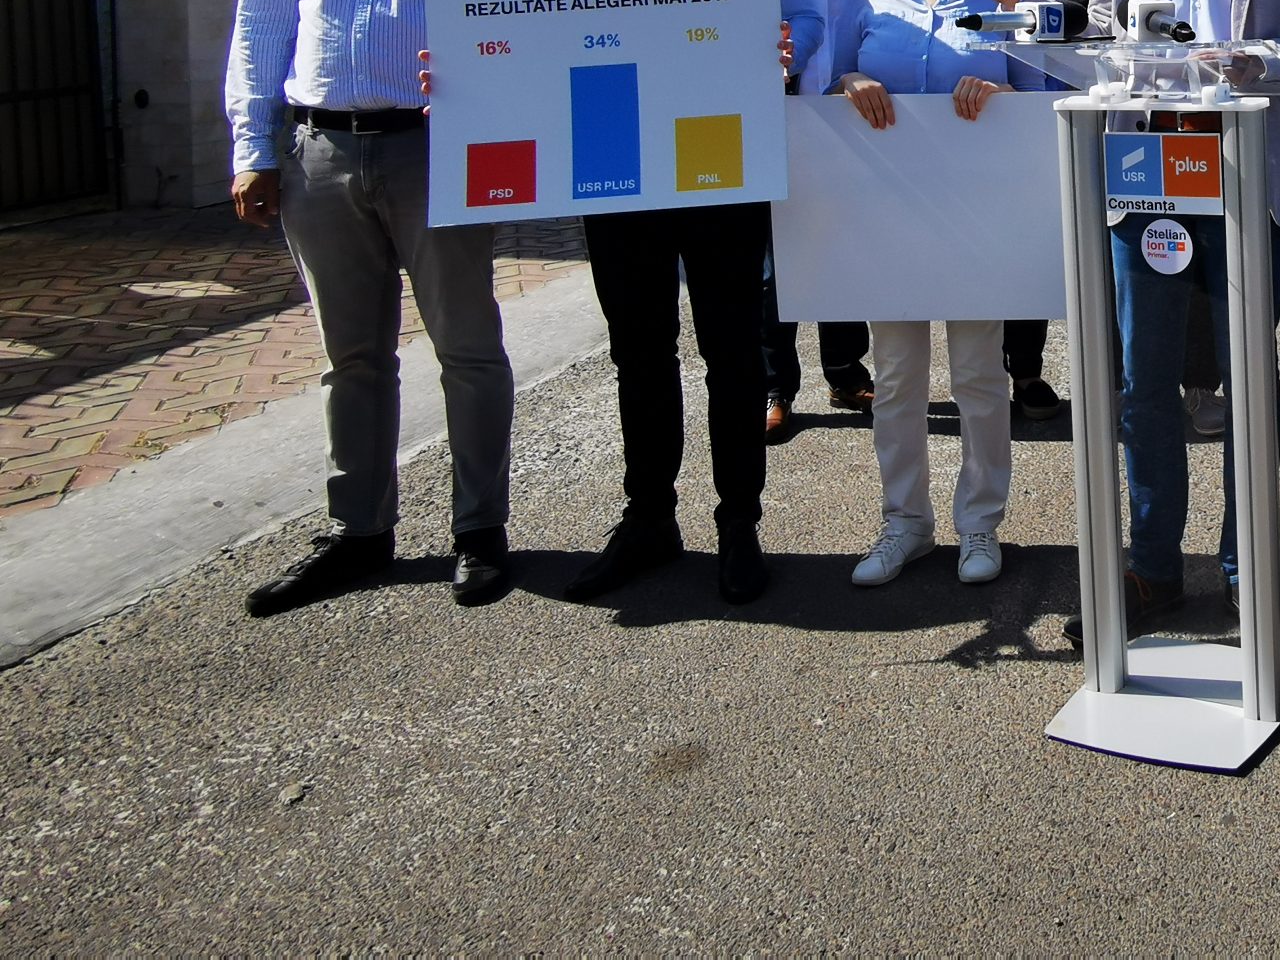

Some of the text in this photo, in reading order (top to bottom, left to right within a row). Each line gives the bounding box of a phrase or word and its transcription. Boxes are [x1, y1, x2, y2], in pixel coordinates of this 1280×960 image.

[583, 33, 621, 49] 34%
[686, 27, 720, 43] 19%
[477, 40, 511, 56] 16%
[697, 173, 721, 184] PNL
[1122, 171, 1146, 182] USR
[577, 179, 636, 193] USR PLUS
[489, 187, 513, 199] PSD
[1108, 198, 1176, 214] Constanța
[1146, 228, 1187, 240] Stelian
[1146, 240, 1165, 250] Ion
